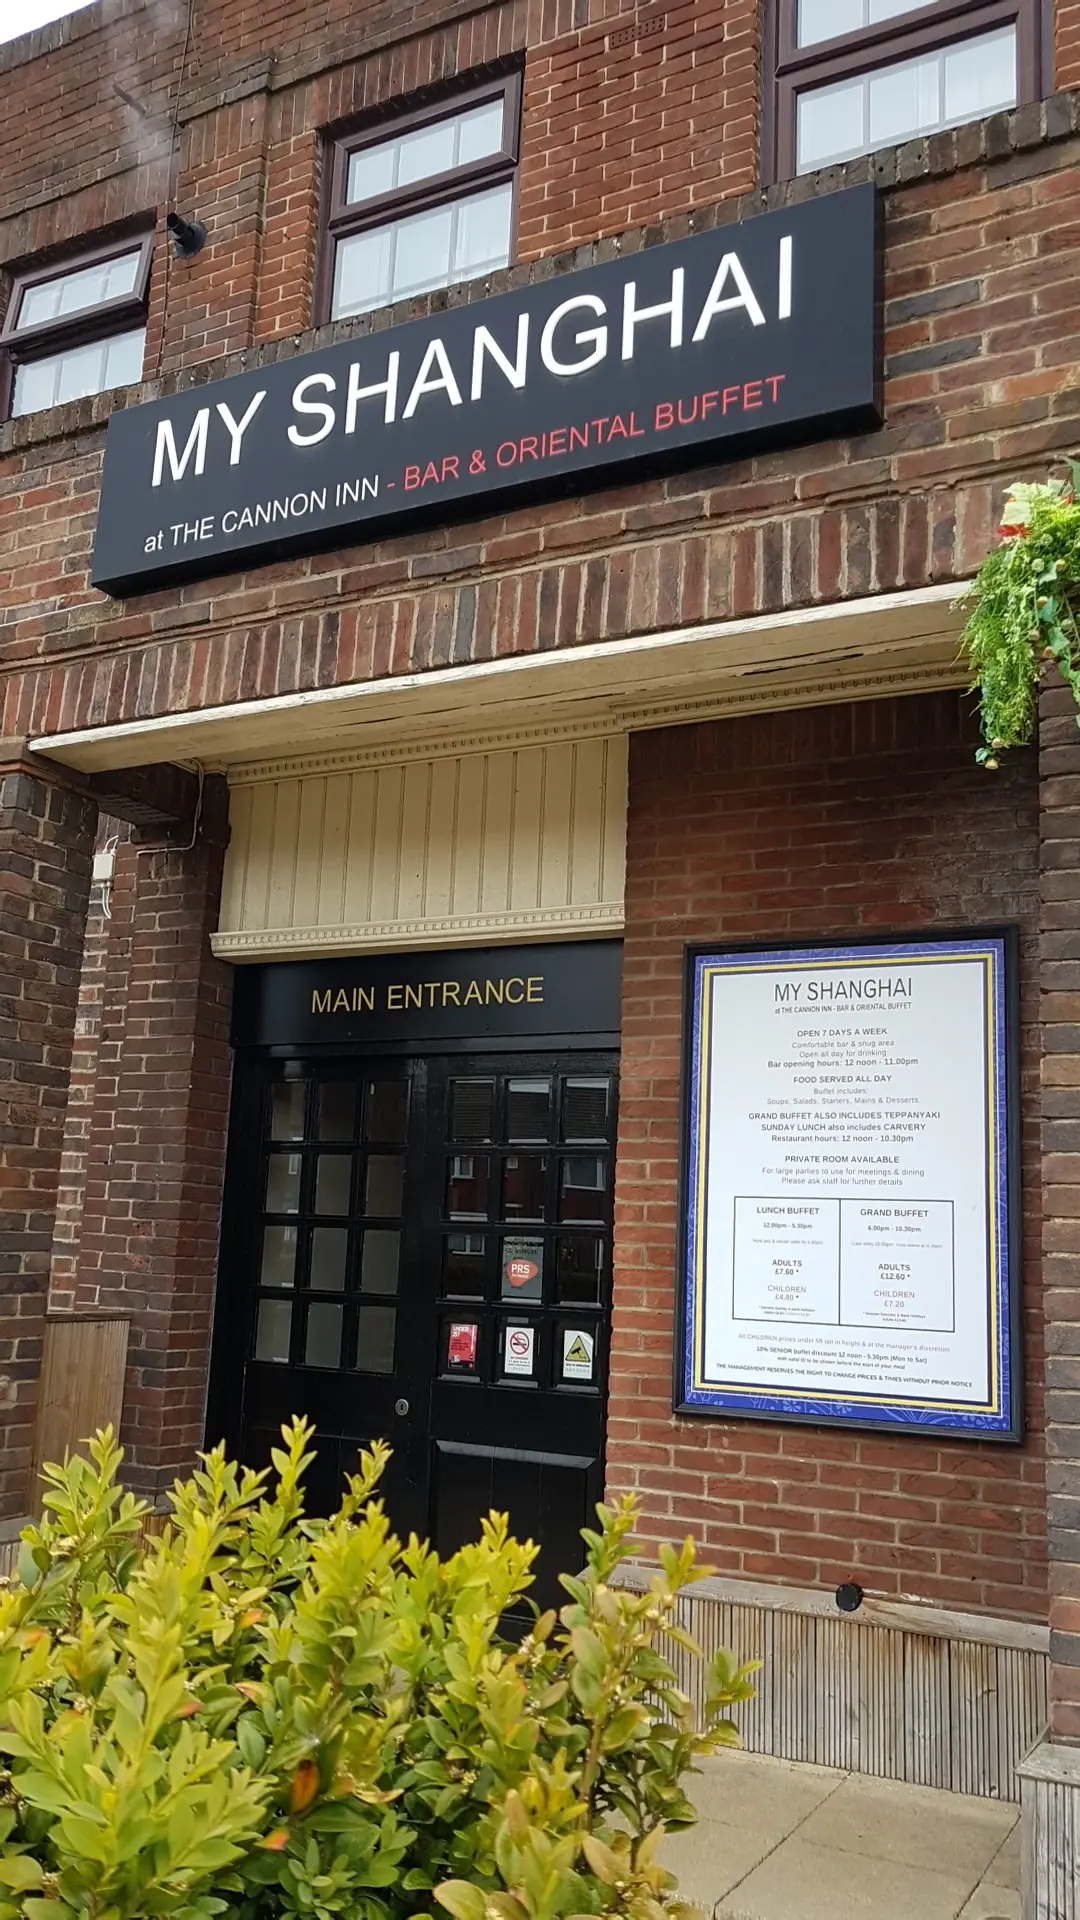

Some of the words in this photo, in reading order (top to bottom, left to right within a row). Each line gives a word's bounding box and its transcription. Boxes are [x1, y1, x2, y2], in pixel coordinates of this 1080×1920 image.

[150, 390, 266, 487] MY
[286, 236, 793, 447] SHANGHAI
[143, 531, 163, 553] at
[169, 517, 215, 543] THE
[220, 492, 327, 534] CANNON
[334, 475, 379, 504] INN
[403, 452, 461, 492] BAR
[469, 449, 487, 472] &
[496, 411, 644, 467] ORIENTAL
[654, 375, 786, 432] BUFFET
[774, 983, 802, 1002] MY
[807, 978, 912, 1001] SHANGHAI
[312, 987, 375, 1013] MAIN
[387, 977, 544, 1009] ENTRANCE
[856, 1003, 886, 1011] ORIENTAL
[768, 1060, 780, 1068] Bar
[783, 1059, 814, 1069] opening
[817, 1059, 842, 1067] hours:
[884, 1058, 919, 1066] 11.00pm
[819, 1075, 853, 1083] SERVED
[874, 1074, 892, 1082] DAY
[884, 1111, 940, 1119] TEPPANYAKI
[828, 1123, 845, 1131] also
[847, 1123, 881, 1131] includes
[883, 1123, 925, 1131] CARVERY
[880, 1135, 914, 1143] 10.30pm
[785, 1155, 820, 1163] PRIVATE
[823, 1155, 848, 1163] ROOM
[851, 1155, 899, 1163] AVAILABLE
[775, 1167, 793, 1176] large
[795, 1168, 819, 1176] parties
[858, 1168, 891, 1177] meetings
[901, 1169, 924, 1177] dining
[894, 1209, 929, 1217] BUFFET
[772, 1259, 802, 1267] ADULTS
[512, 1264, 529, 1273] PRS
[874, 1290, 915, 1298] CHILDREN
